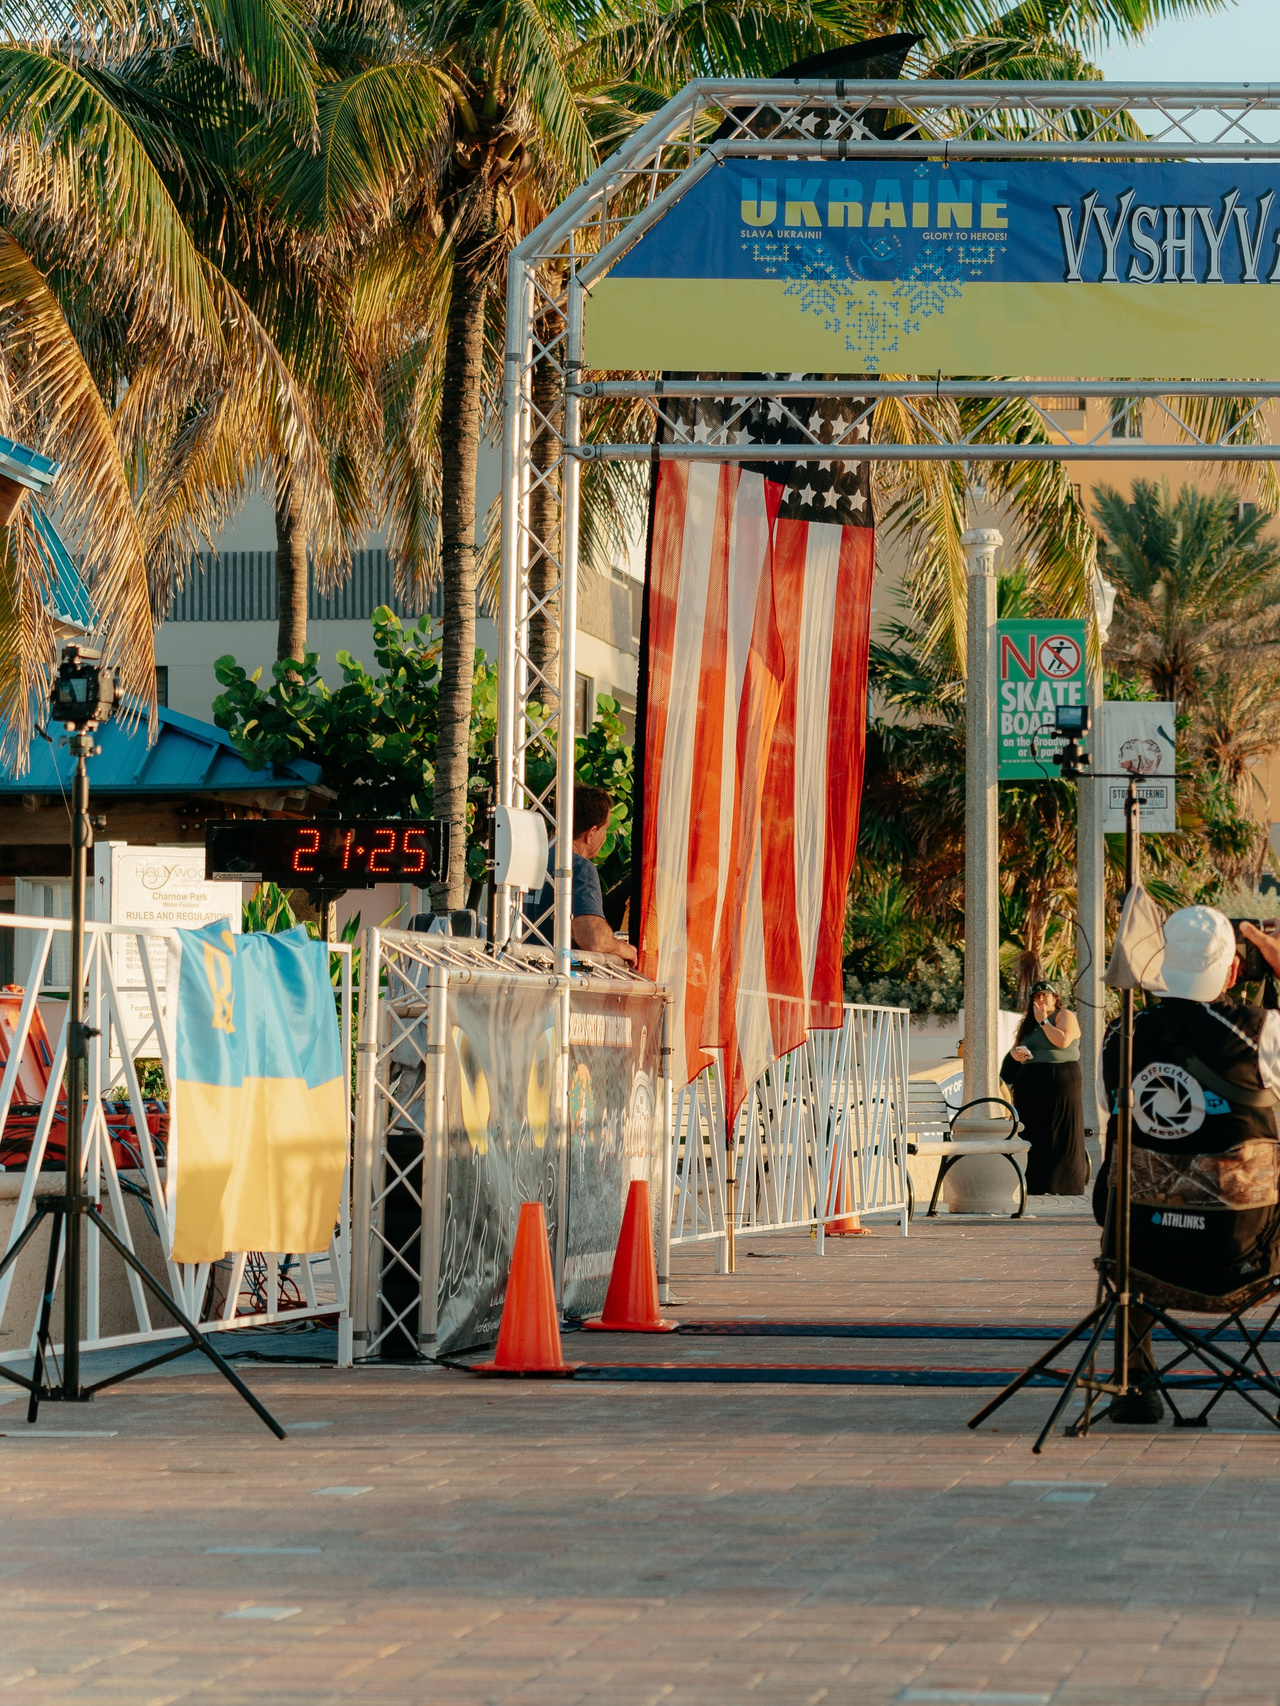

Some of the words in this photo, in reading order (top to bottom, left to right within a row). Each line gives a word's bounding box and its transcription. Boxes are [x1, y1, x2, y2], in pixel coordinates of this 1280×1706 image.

[741, 177, 1009, 229] UKRAINE
[740, 229, 774, 238] SLAVA
[777, 230, 822, 240] UKRAINI!
[922, 231, 954, 240] GLORY
[956, 232, 968, 240] TO
[970, 232, 1008, 241] HEROES!
[1001, 681, 1082, 713] SKATE
[1001, 712, 1056, 735] BOAR
[1003, 738, 1015, 747] on
[1016, 736, 1032, 747] the
[1018, 748, 1028, 757] or
[152, 892, 188, 901] Charnow
[190, 892, 208, 901] Park
[126, 911, 154, 920] RULES
[156, 911, 175, 920] AND
[176, 911, 234, 921] REGULATIONS
[1141, 1066, 1190, 1085] OFFICIAL
[954, 1080, 963, 1093] OF
[1148, 1126, 1188, 1137] MEDIA
[1161, 1212, 1205, 1230] ATHLINKS
